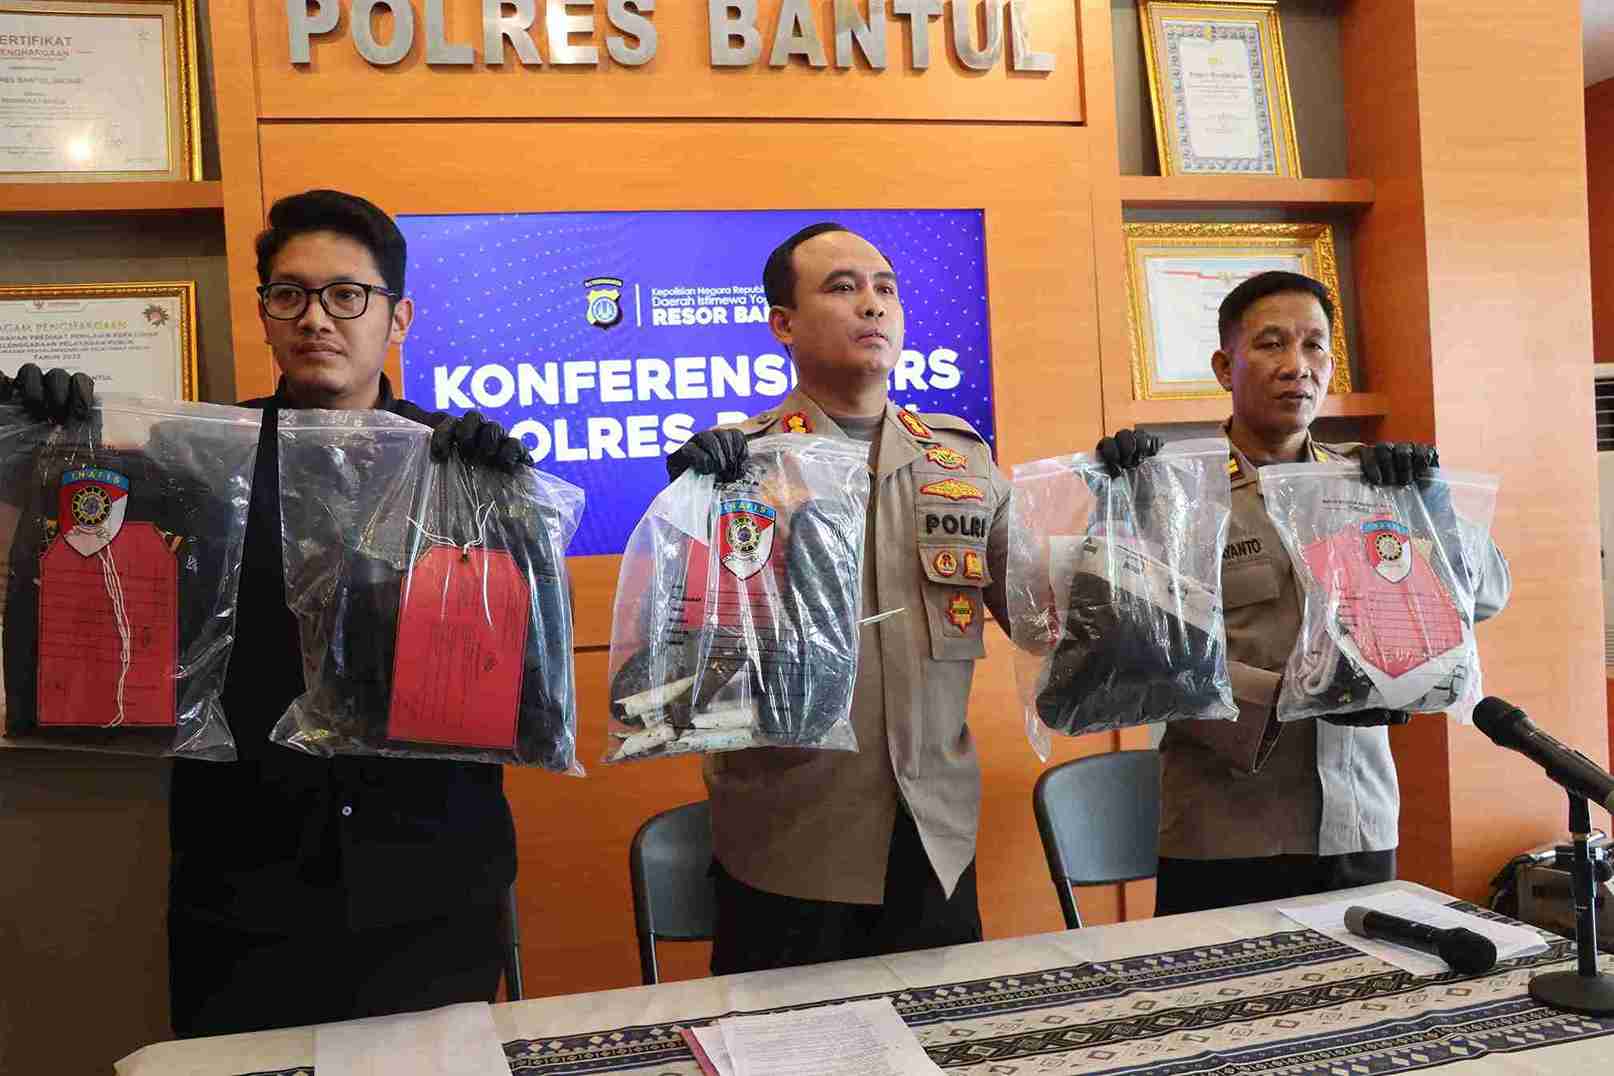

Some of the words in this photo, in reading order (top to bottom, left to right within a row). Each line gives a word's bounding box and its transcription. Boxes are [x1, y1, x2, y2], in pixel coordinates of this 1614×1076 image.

[284, 0, 658, 66] POLRES
[707, 0, 1057, 72] BANTUL
[652, 297, 696, 306] Daerah
[697, 295, 746, 305] Istimewa
[698, 287, 731, 297] Negara
[733, 286, 765, 295] Republi
[652, 307, 728, 326] RESOR
[508, 413, 696, 464] OLRES
[926, 513, 986, 538] POLRI
